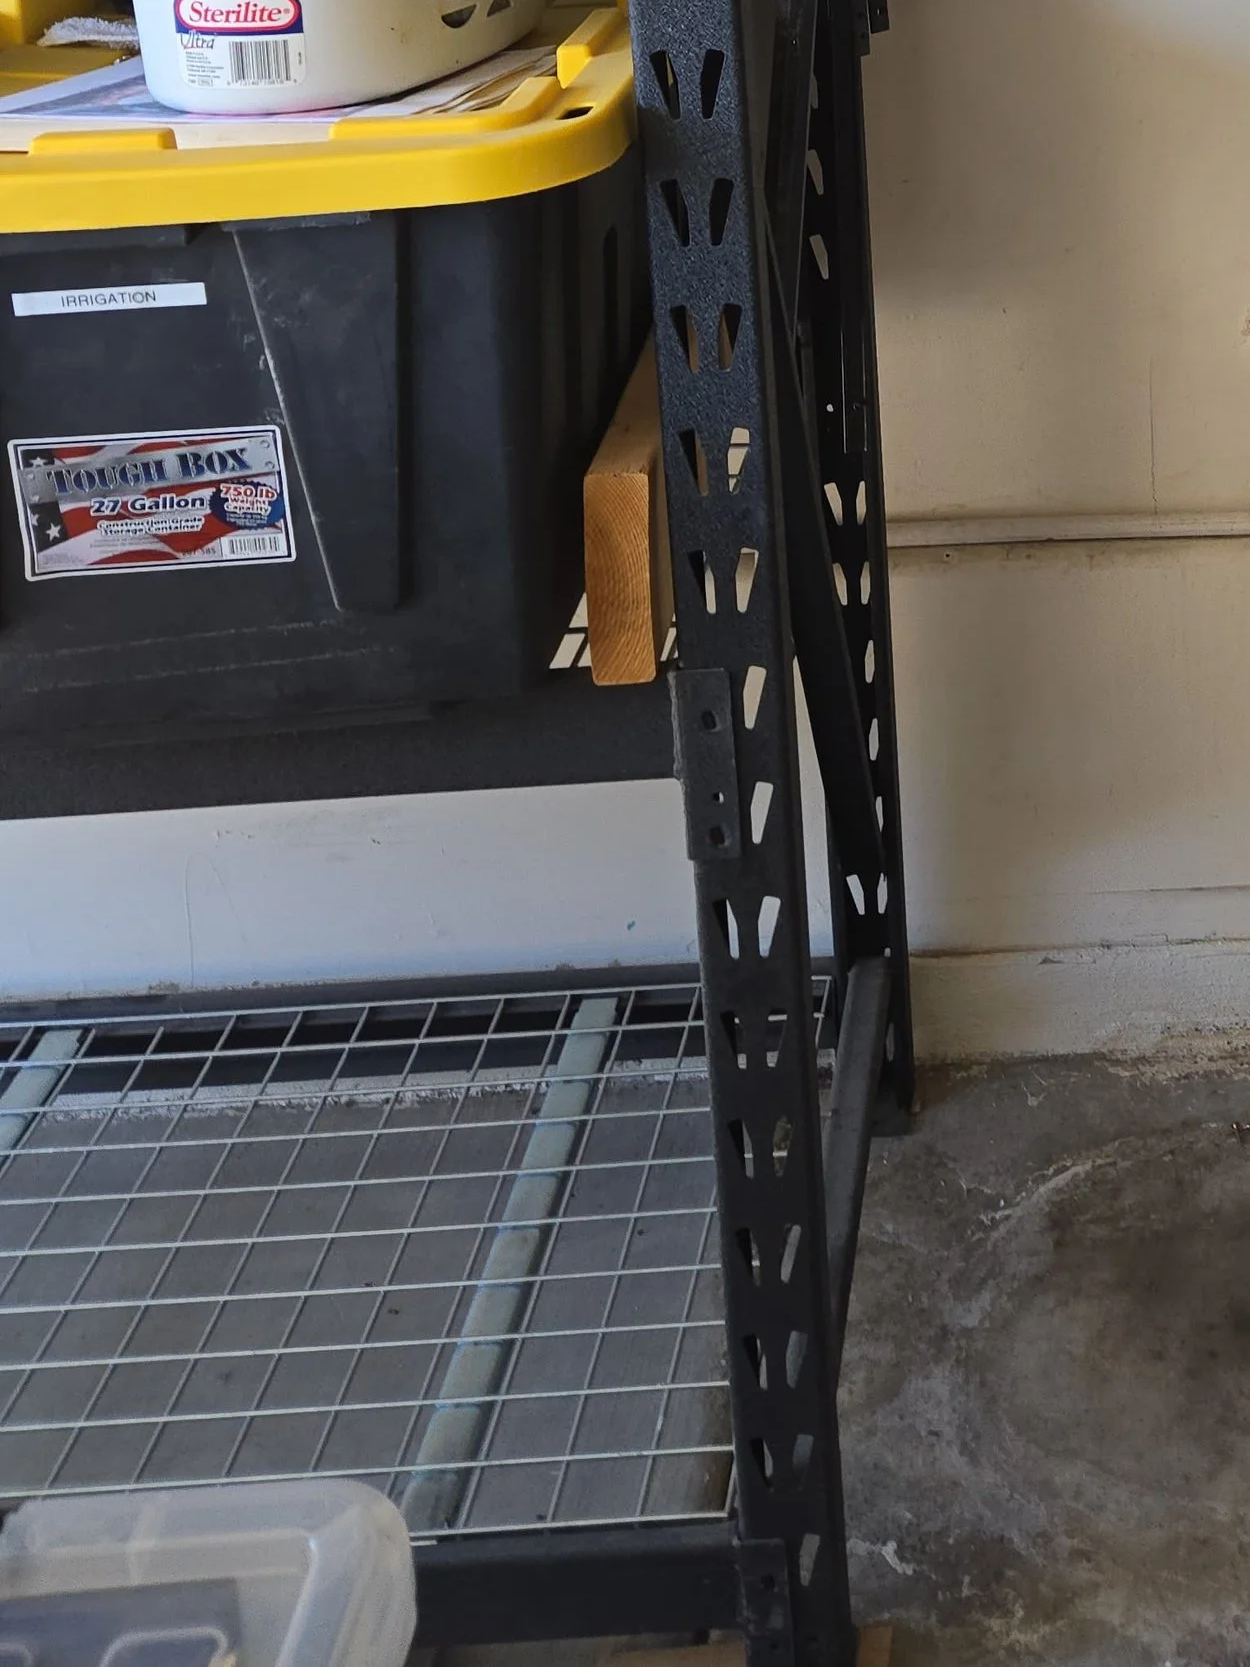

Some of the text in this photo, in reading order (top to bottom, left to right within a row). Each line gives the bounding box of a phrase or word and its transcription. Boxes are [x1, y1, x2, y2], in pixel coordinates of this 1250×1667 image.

[180, 30, 216, 50] Ultra
[61, 291, 157, 307] IRRIGATION
[221, 485, 276, 499] 750 lb
[91, 495, 205, 514] 27 Gallon
